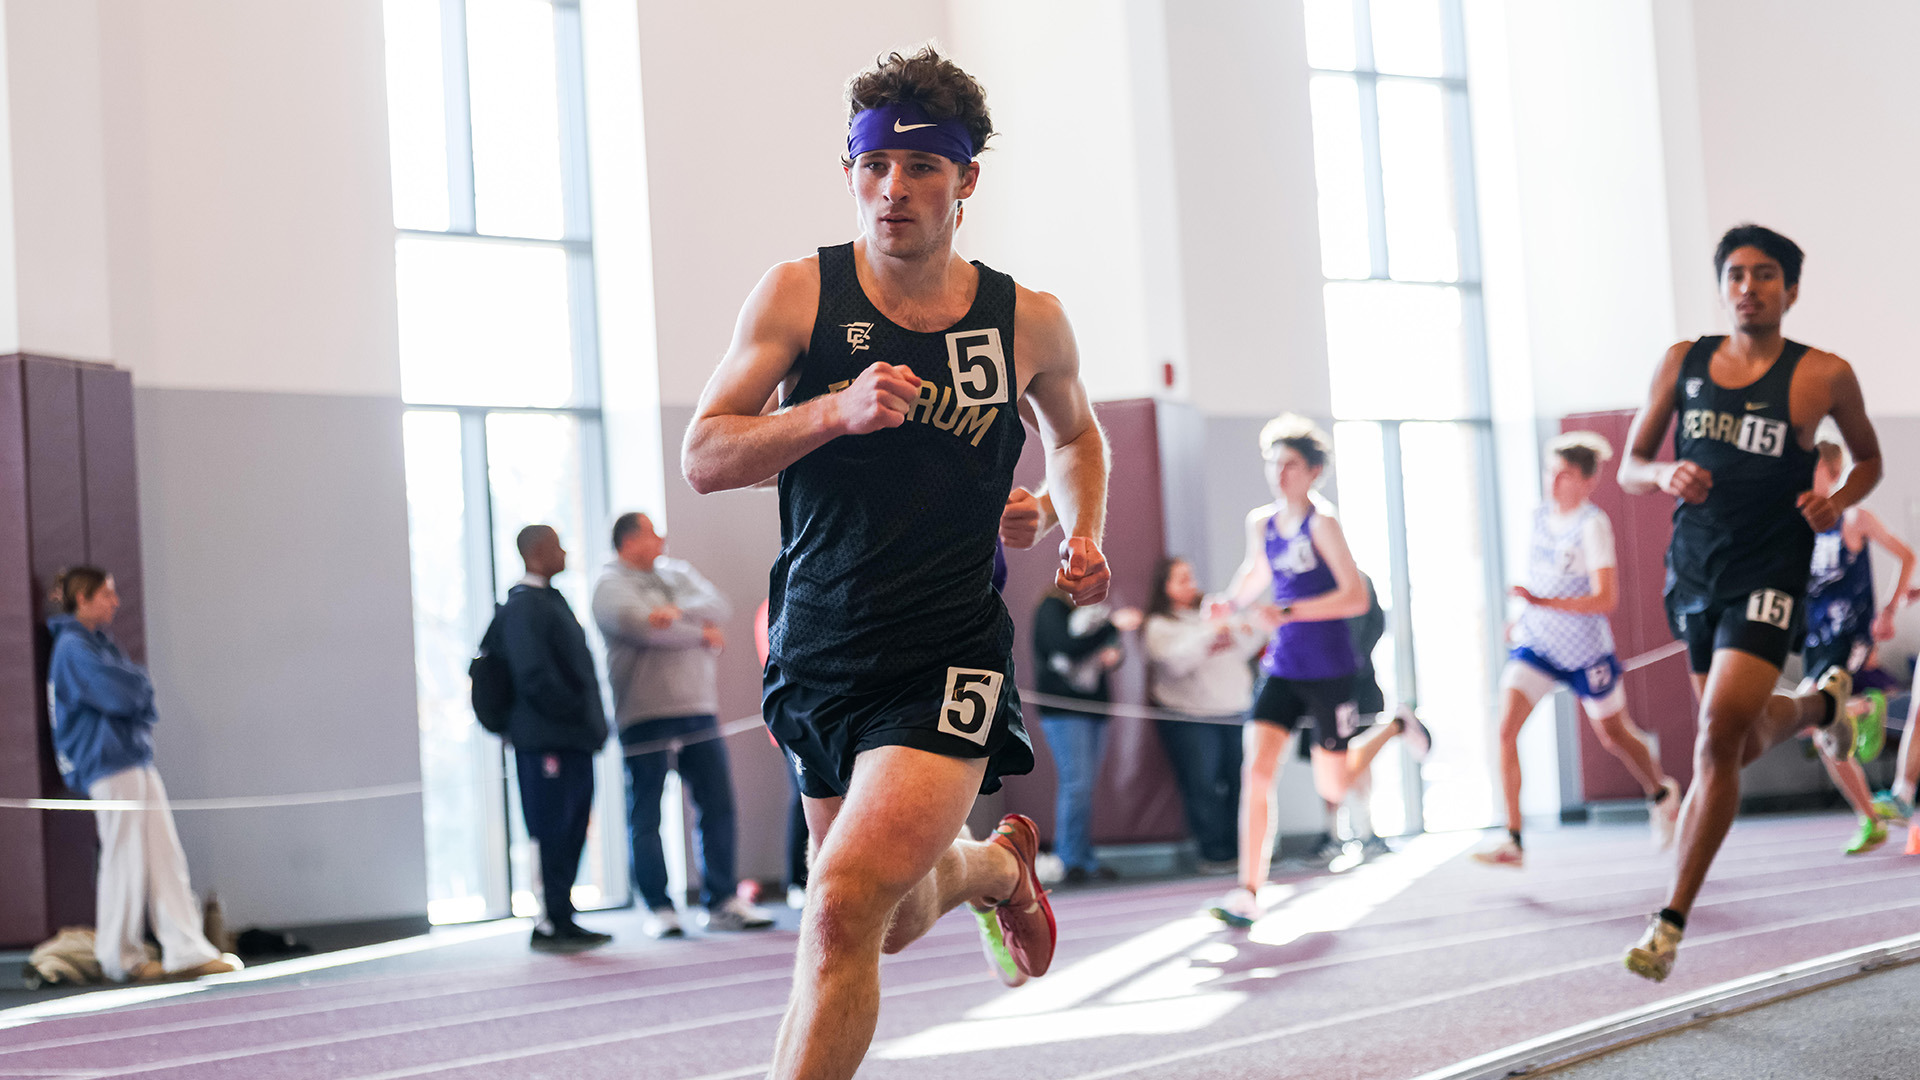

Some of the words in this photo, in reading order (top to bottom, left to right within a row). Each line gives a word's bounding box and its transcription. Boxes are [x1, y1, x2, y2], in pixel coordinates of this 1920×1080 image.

[955, 334, 999, 400] 5
[827, 378, 999, 447] RUM
[1682, 409, 1743, 447] FERR
[1747, 420, 1779, 454] 15
[1755, 592, 1785, 624] 15
[946, 672, 992, 734] 5
